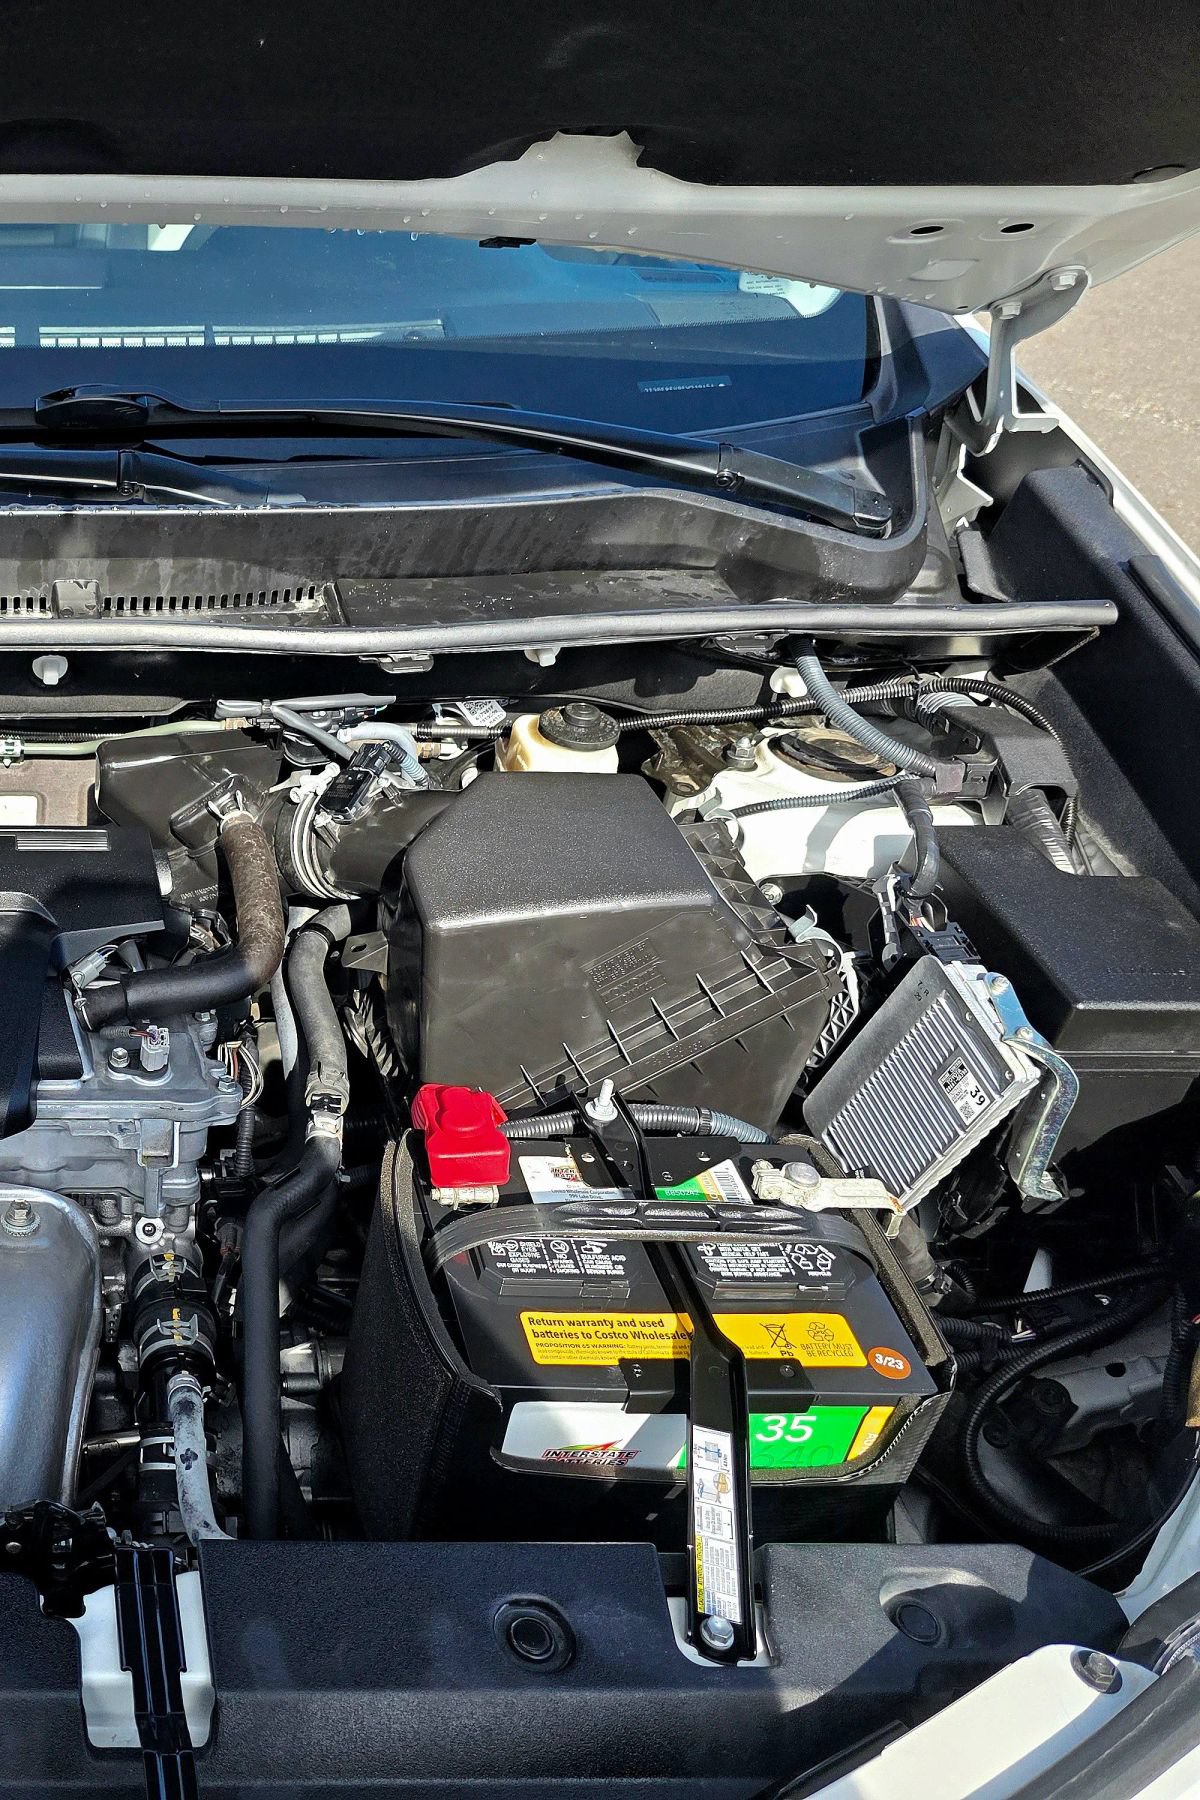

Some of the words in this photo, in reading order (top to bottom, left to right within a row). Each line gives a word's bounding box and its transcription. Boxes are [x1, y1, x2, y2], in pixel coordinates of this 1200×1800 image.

[970, 1085, 985, 1105] 39
[528, 1317, 564, 1327] Return
[566, 1318, 614, 1328] warranty
[617, 1318, 636, 1327] and
[639, 1319, 664, 1327] used
[533, 1330, 579, 1339] batteries
[595, 1331, 628, 1339] Costco
[632, 1331, 687, 1340] Wholesale
[874, 1353, 904, 1370] 3/23
[756, 1416, 816, 1442] 35
